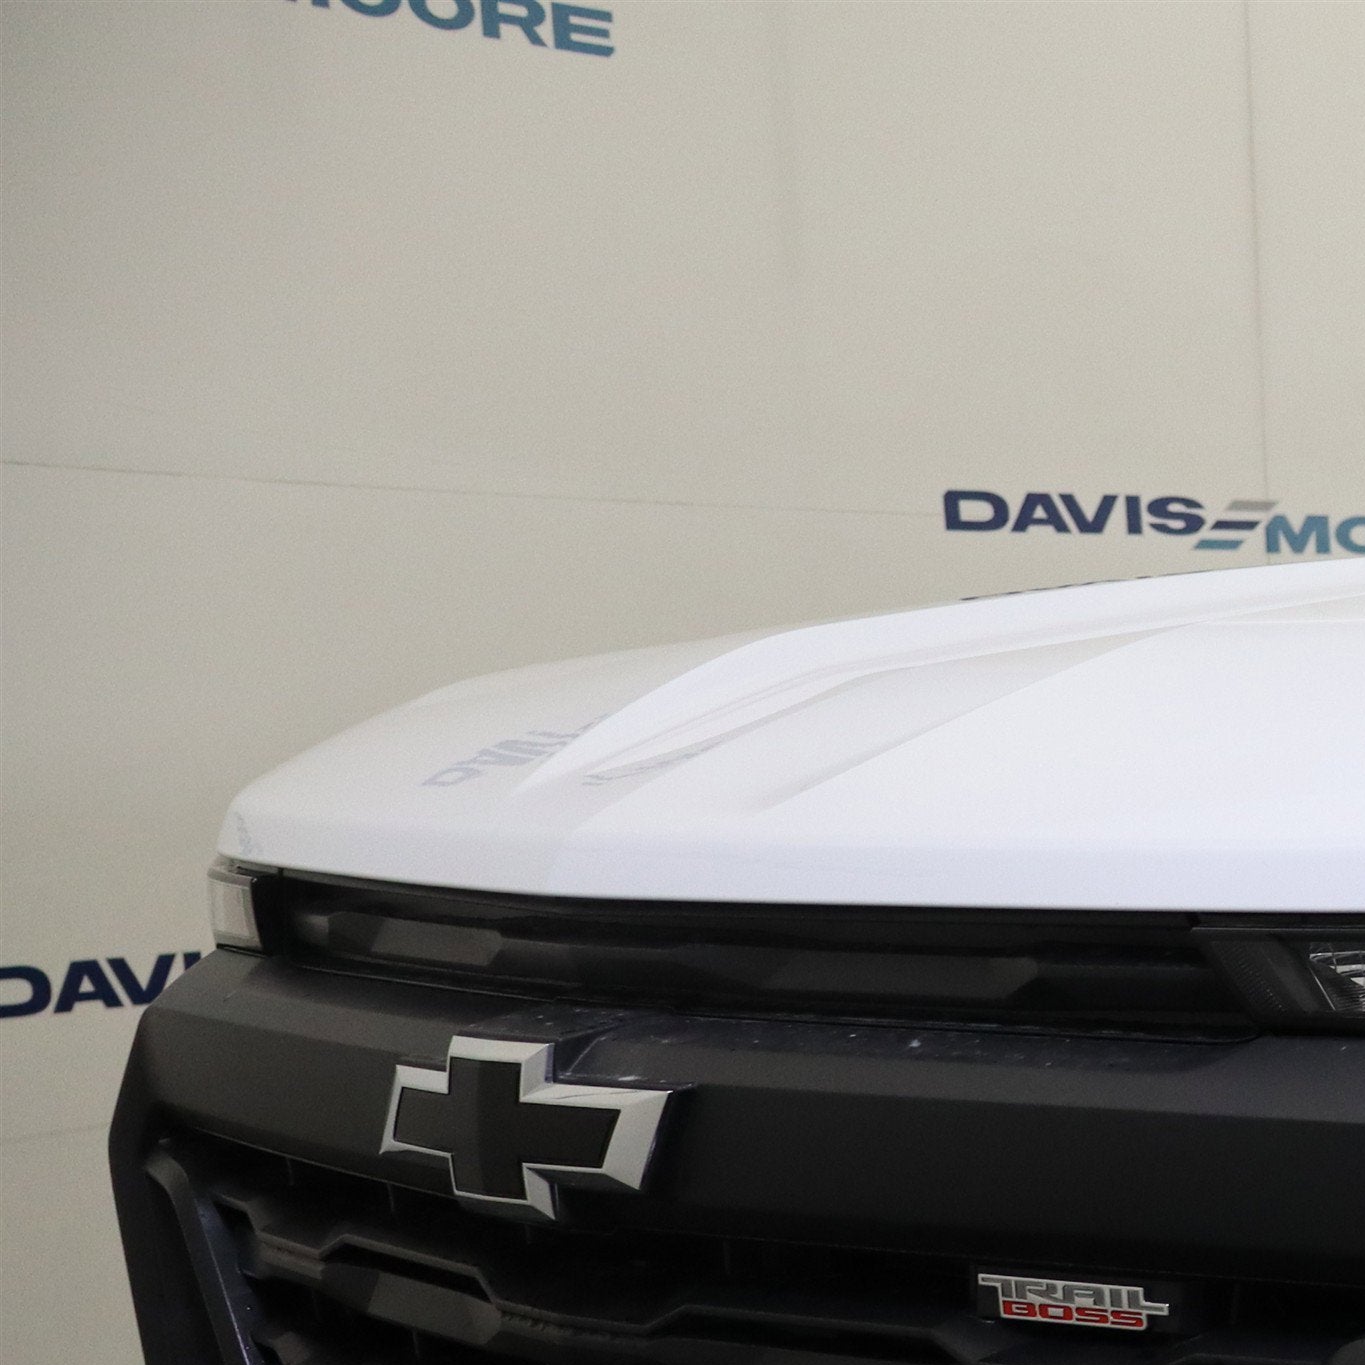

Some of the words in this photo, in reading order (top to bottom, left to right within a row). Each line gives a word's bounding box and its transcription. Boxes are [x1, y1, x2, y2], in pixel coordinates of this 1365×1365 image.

[283, 0, 615, 58] ORE
[943, 490, 1206, 535] DAVIS
[0, 952, 201, 1018] DAV
[978, 1273, 1170, 1316] TRAIL
[1001, 1299, 1147, 1331] BOSS
